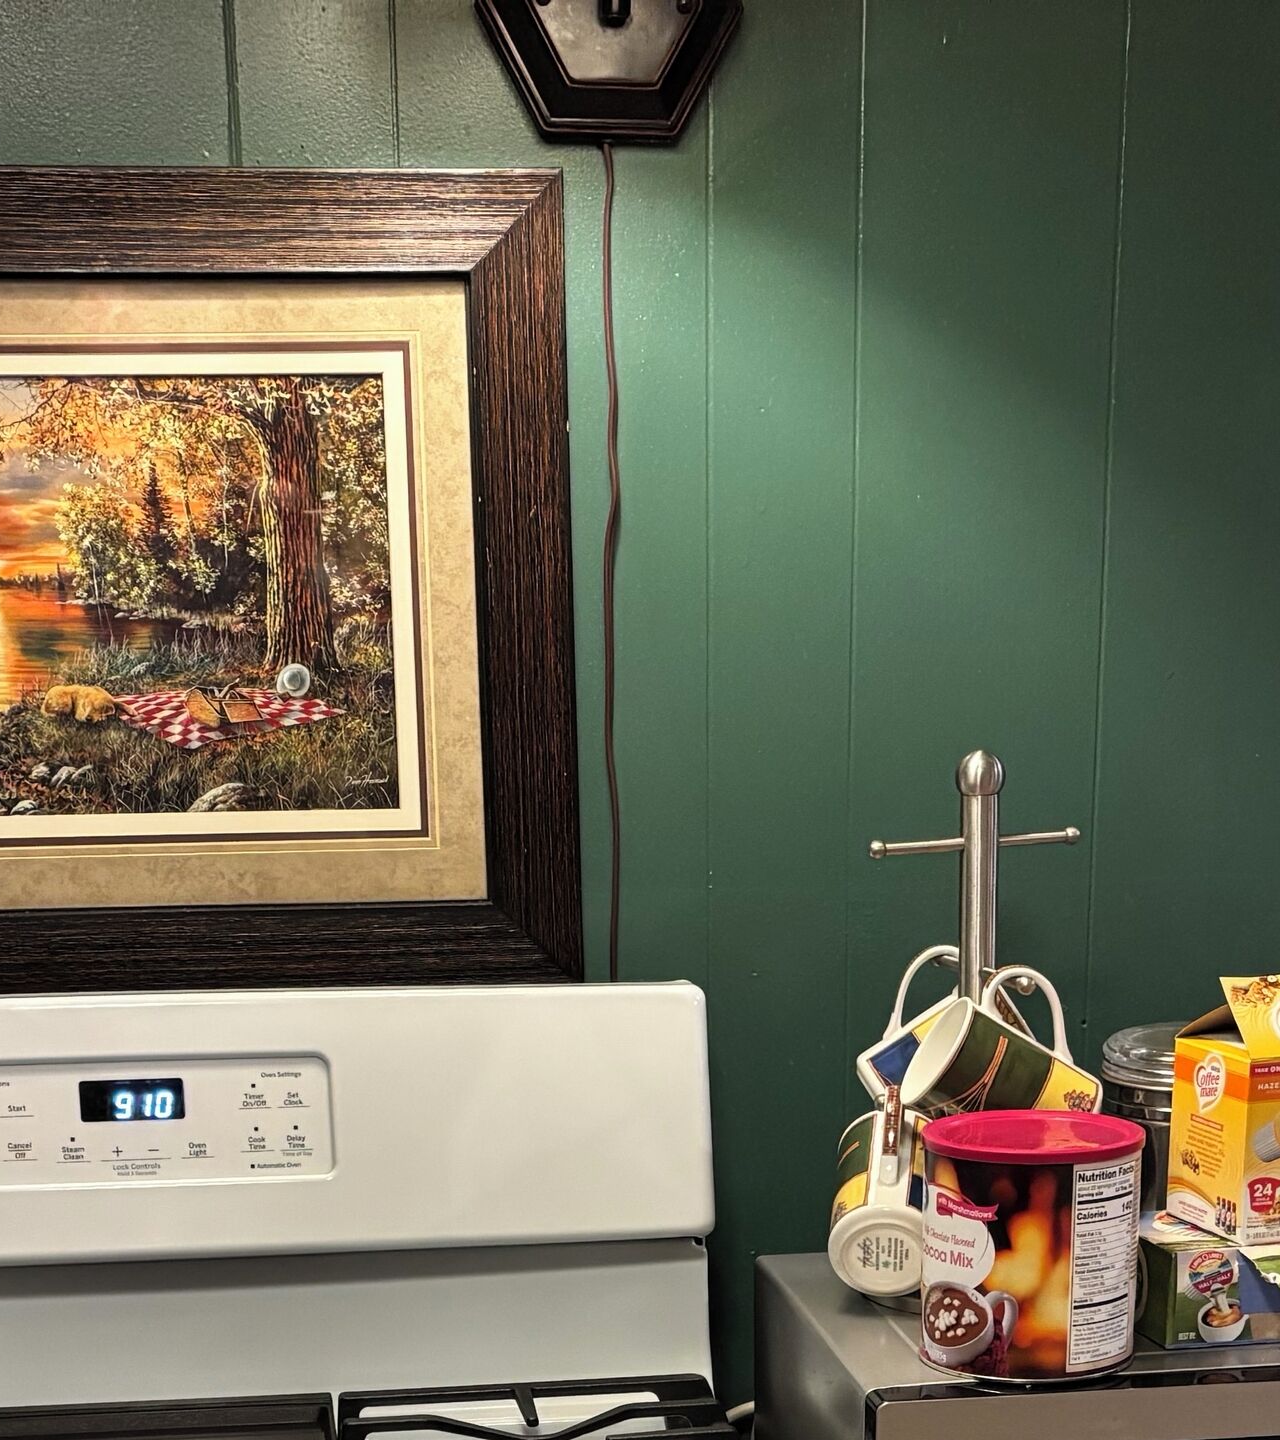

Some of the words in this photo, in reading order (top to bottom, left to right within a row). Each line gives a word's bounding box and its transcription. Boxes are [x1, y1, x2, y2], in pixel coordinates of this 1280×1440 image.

[1196, 1065, 1220, 1088] Coffee
[1078, 1170, 1117, 1183] Nutrition
[1254, 1183, 1273, 1197] 24
[1077, 1210, 1108, 1221] Calories
[950, 1250, 974, 1269] Mix
